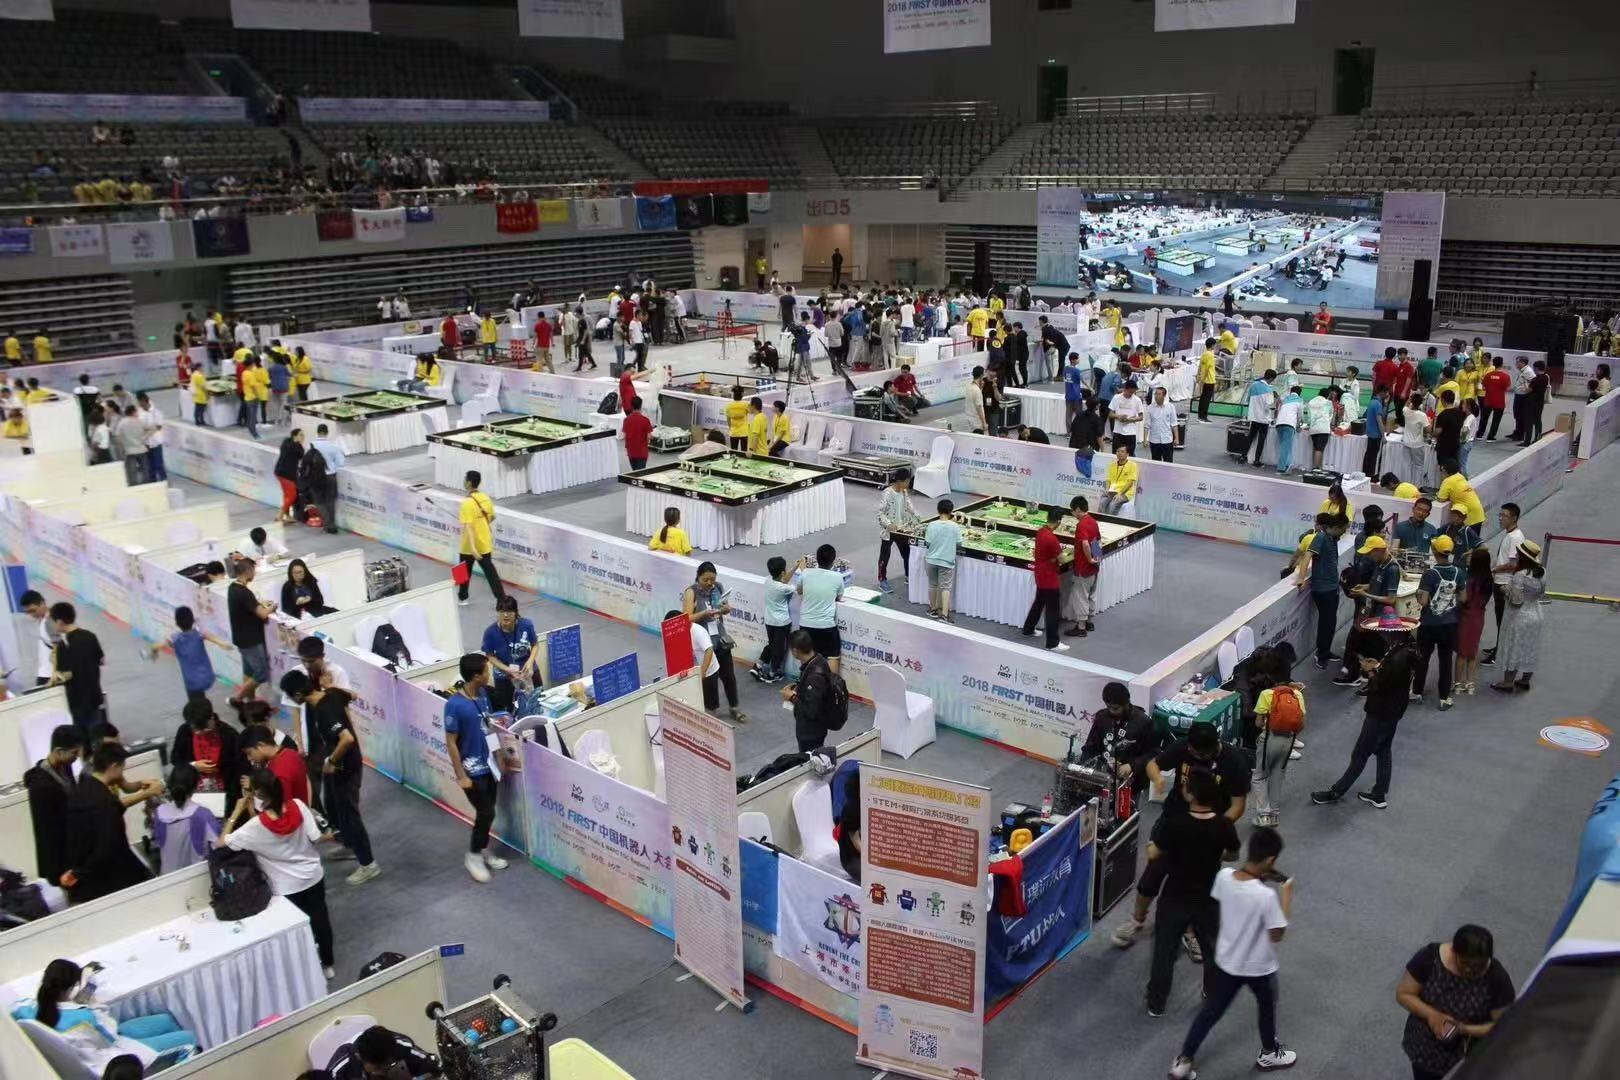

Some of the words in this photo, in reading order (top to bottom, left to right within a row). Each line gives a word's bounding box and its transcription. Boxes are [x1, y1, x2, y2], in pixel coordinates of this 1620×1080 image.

[807, 199, 850, 217] 出口5
[971, 459, 989, 468] FIRST
[990, 462, 1018, 473] 中国机器人
[1020, 467, 1032, 476] 大会
[1056, 473, 1074, 482] 2018
[1075, 477, 1096, 486] FIRST
[1172, 492, 1191, 502] 2018
[1192, 495, 1216, 506] FIRST
[1216, 500, 1252, 513] 中国机器人
[1254, 505, 1270, 515] 大会
[608, 571, 638, 588] 中国机器人
[859, 645, 903, 667] 中国机器人
[904, 659, 923, 672] 大会
[962, 675, 989, 693] 2018
[990, 684, 1025, 701] FIRST
[1025, 694, 1077, 720] 中国机器人
[571, 792, 584, 802] FIRST
[540, 794, 566, 817] 2018
[567, 809, 598, 832] FIRST
[599, 825, 650, 860] 中国机器人
[653, 850, 672, 871] 大会
